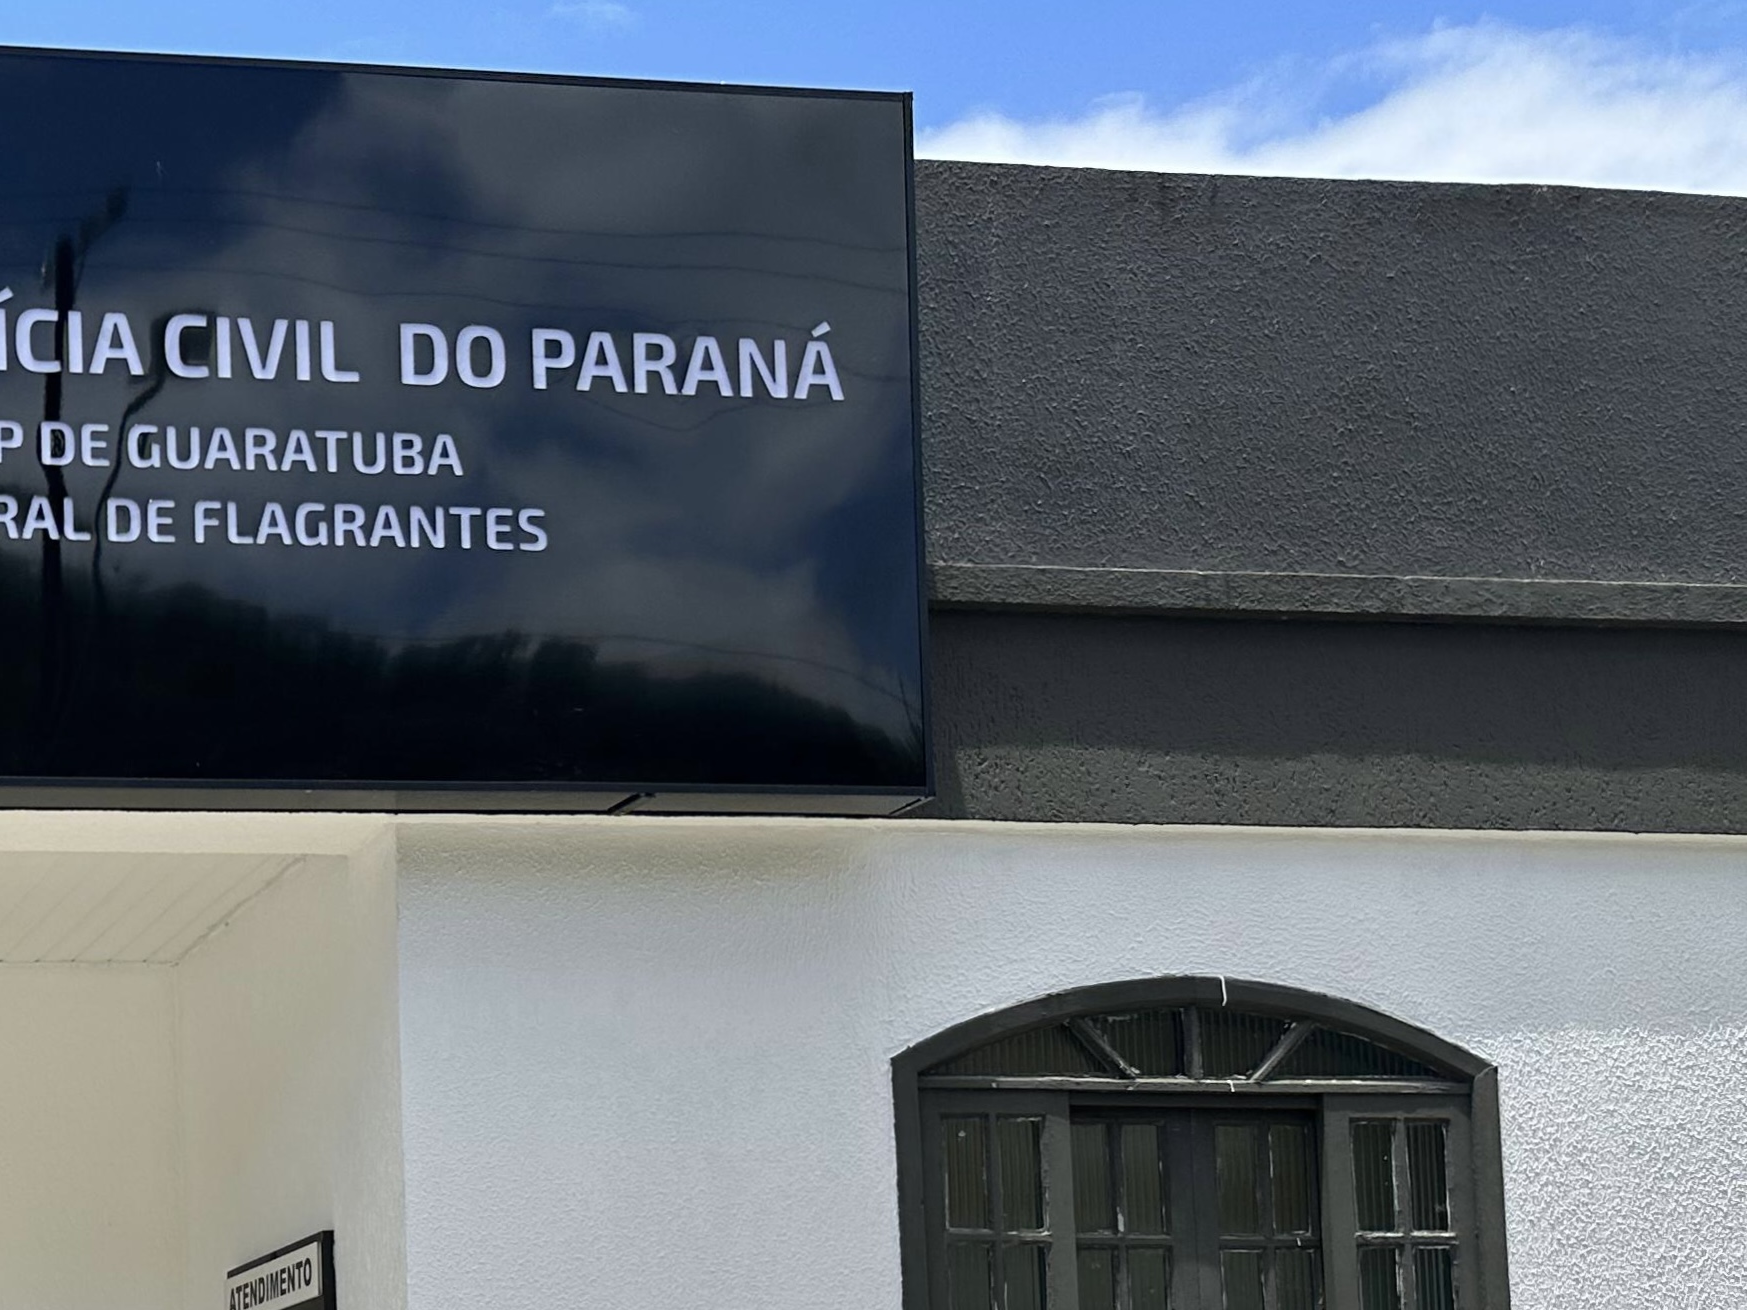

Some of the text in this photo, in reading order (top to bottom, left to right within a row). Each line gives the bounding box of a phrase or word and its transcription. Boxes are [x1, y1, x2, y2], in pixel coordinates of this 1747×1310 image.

[163, 315, 360, 383] CIVIL
[400, 323, 506, 388] DO
[532, 321, 846, 401] PARANÁ
[40, 422, 110, 467] DE
[126, 424, 463, 476] GUARATUBA
[107, 499, 176, 543] DE
[194, 501, 548, 551] FLAGRANTES
